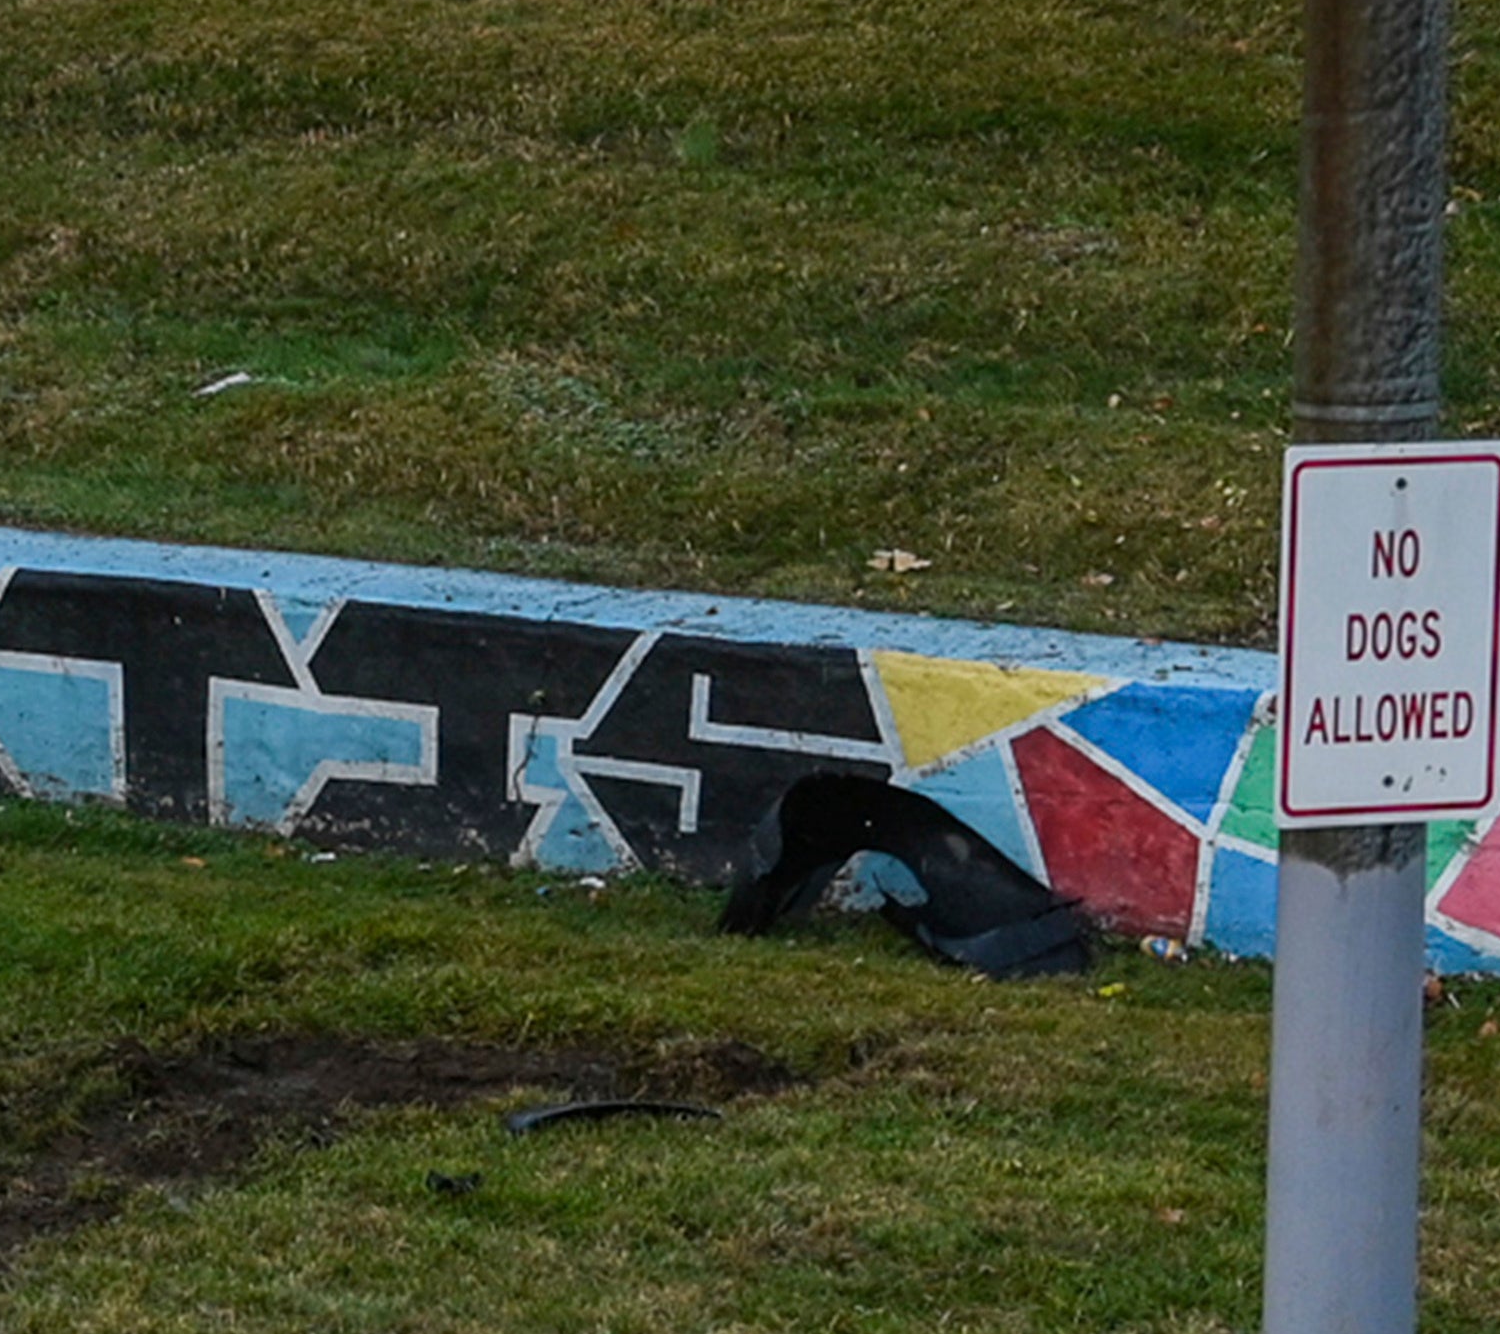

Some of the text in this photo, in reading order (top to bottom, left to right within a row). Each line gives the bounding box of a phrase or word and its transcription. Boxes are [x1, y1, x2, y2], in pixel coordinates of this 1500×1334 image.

[1371, 529, 1420, 579] NO
[1346, 610, 1441, 662] DOGS
[1304, 691, 1474, 745] ALLOWED
